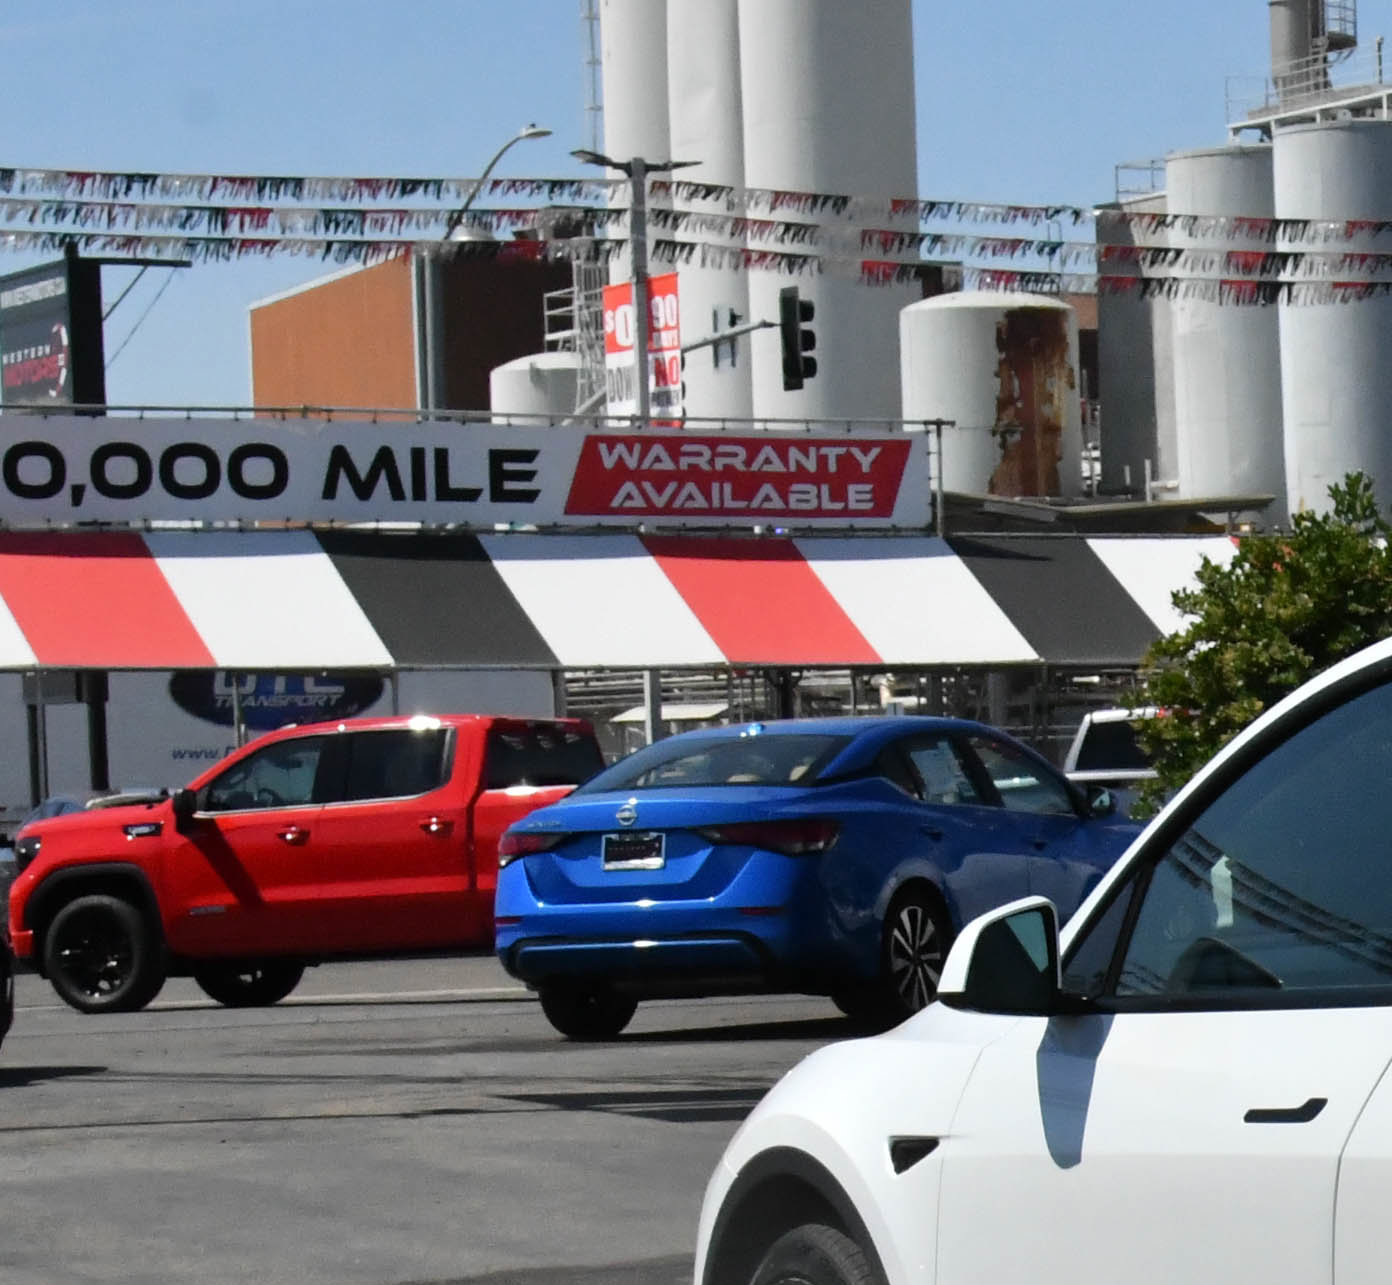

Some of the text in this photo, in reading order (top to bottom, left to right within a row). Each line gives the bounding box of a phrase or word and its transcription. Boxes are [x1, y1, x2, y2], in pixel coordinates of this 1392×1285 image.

[651, 294, 678, 328] 90
[597, 442, 882, 473] WARRANTY
[3, 441, 542, 507] 0,000 MILE
[609, 481, 875, 510] AVAILABLE
